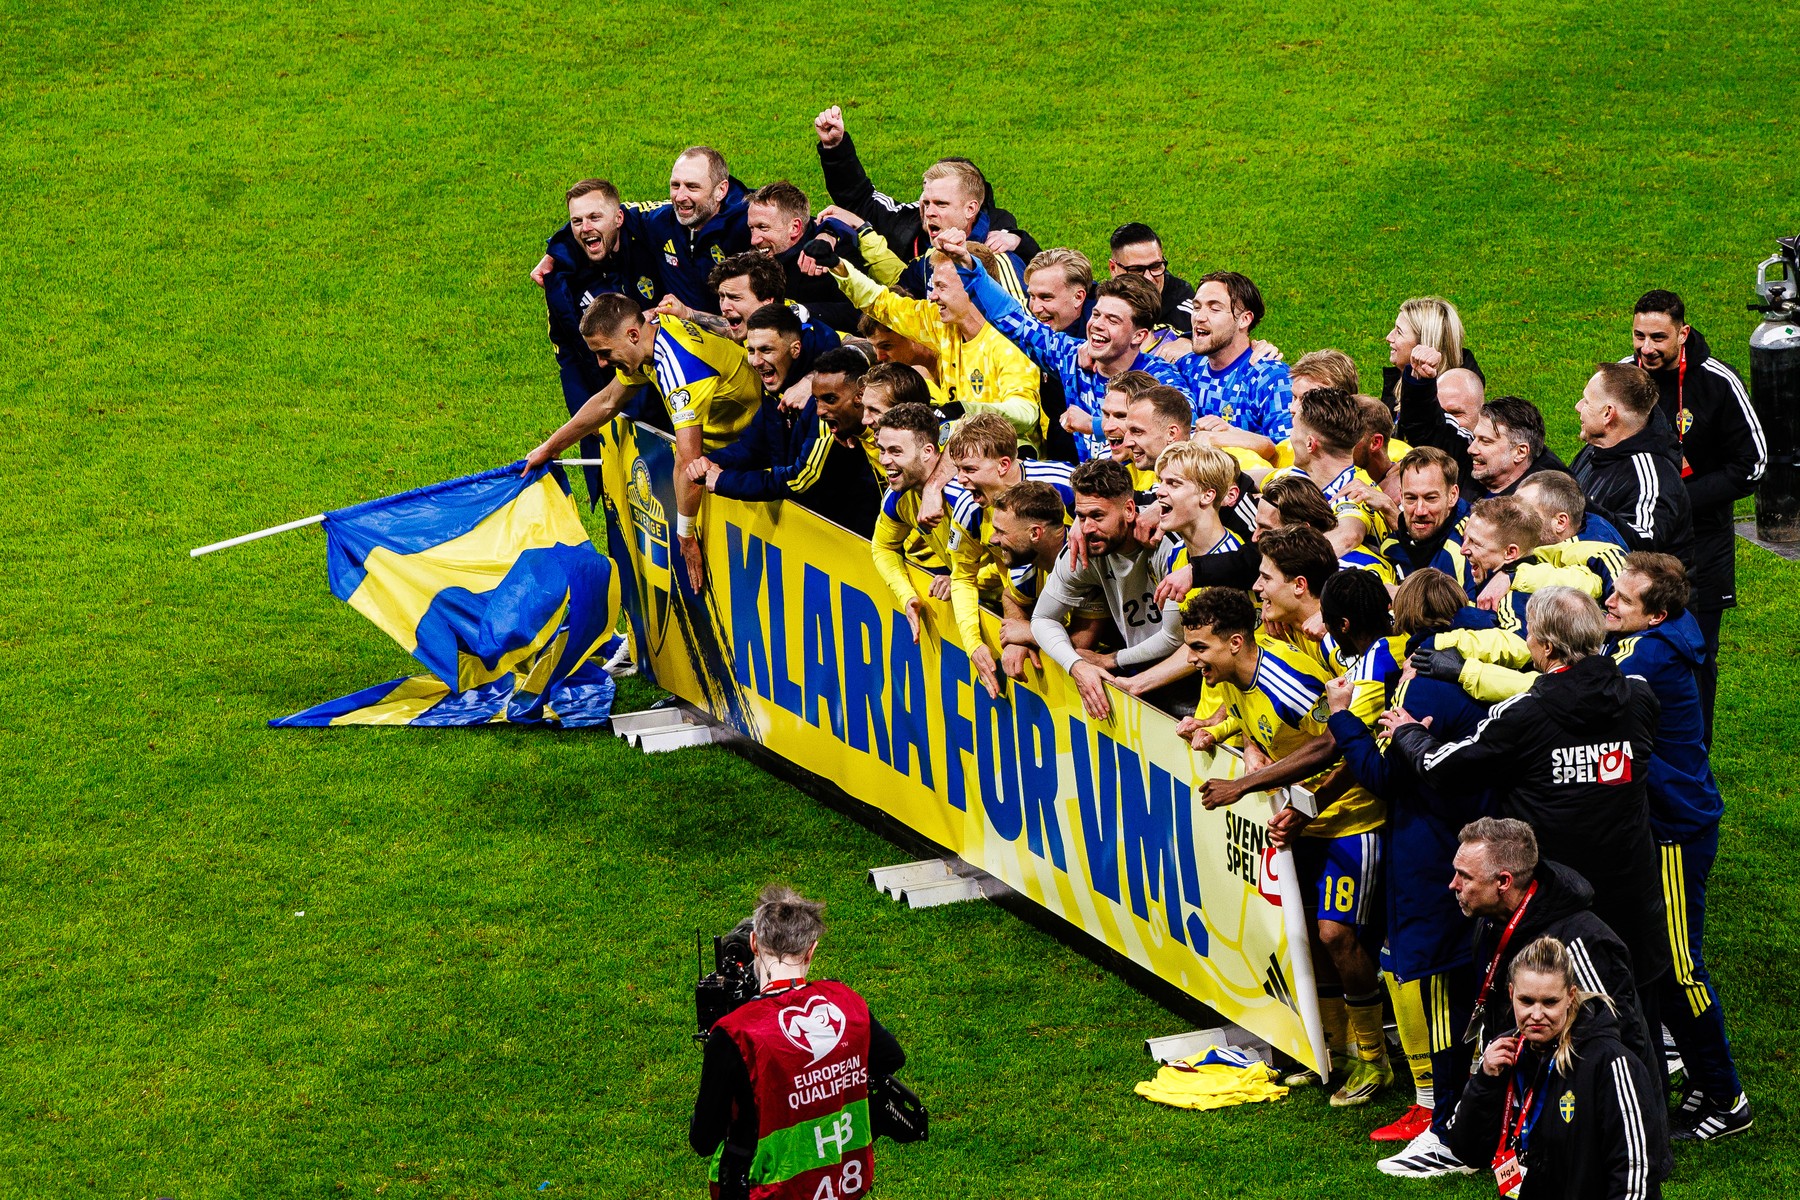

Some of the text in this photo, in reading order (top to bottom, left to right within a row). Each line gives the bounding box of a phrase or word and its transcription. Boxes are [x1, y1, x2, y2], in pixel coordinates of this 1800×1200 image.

[633, 508, 662, 537] SVERIGE
[1122, 592, 1163, 627] 23
[725, 520, 1209, 958] KLARA FÖR VM!
[1551, 740, 1634, 767] SVENSKA
[1552, 764, 1597, 784] SPEL
[1227, 842, 1257, 886] SPEL
[1324, 875, 1355, 912] 18
[788, 1067, 868, 1110] QUALIFIERS
[793, 1055, 861, 1089] EUROPEAN
[1500, 1165, 1515, 1179] Hg4
